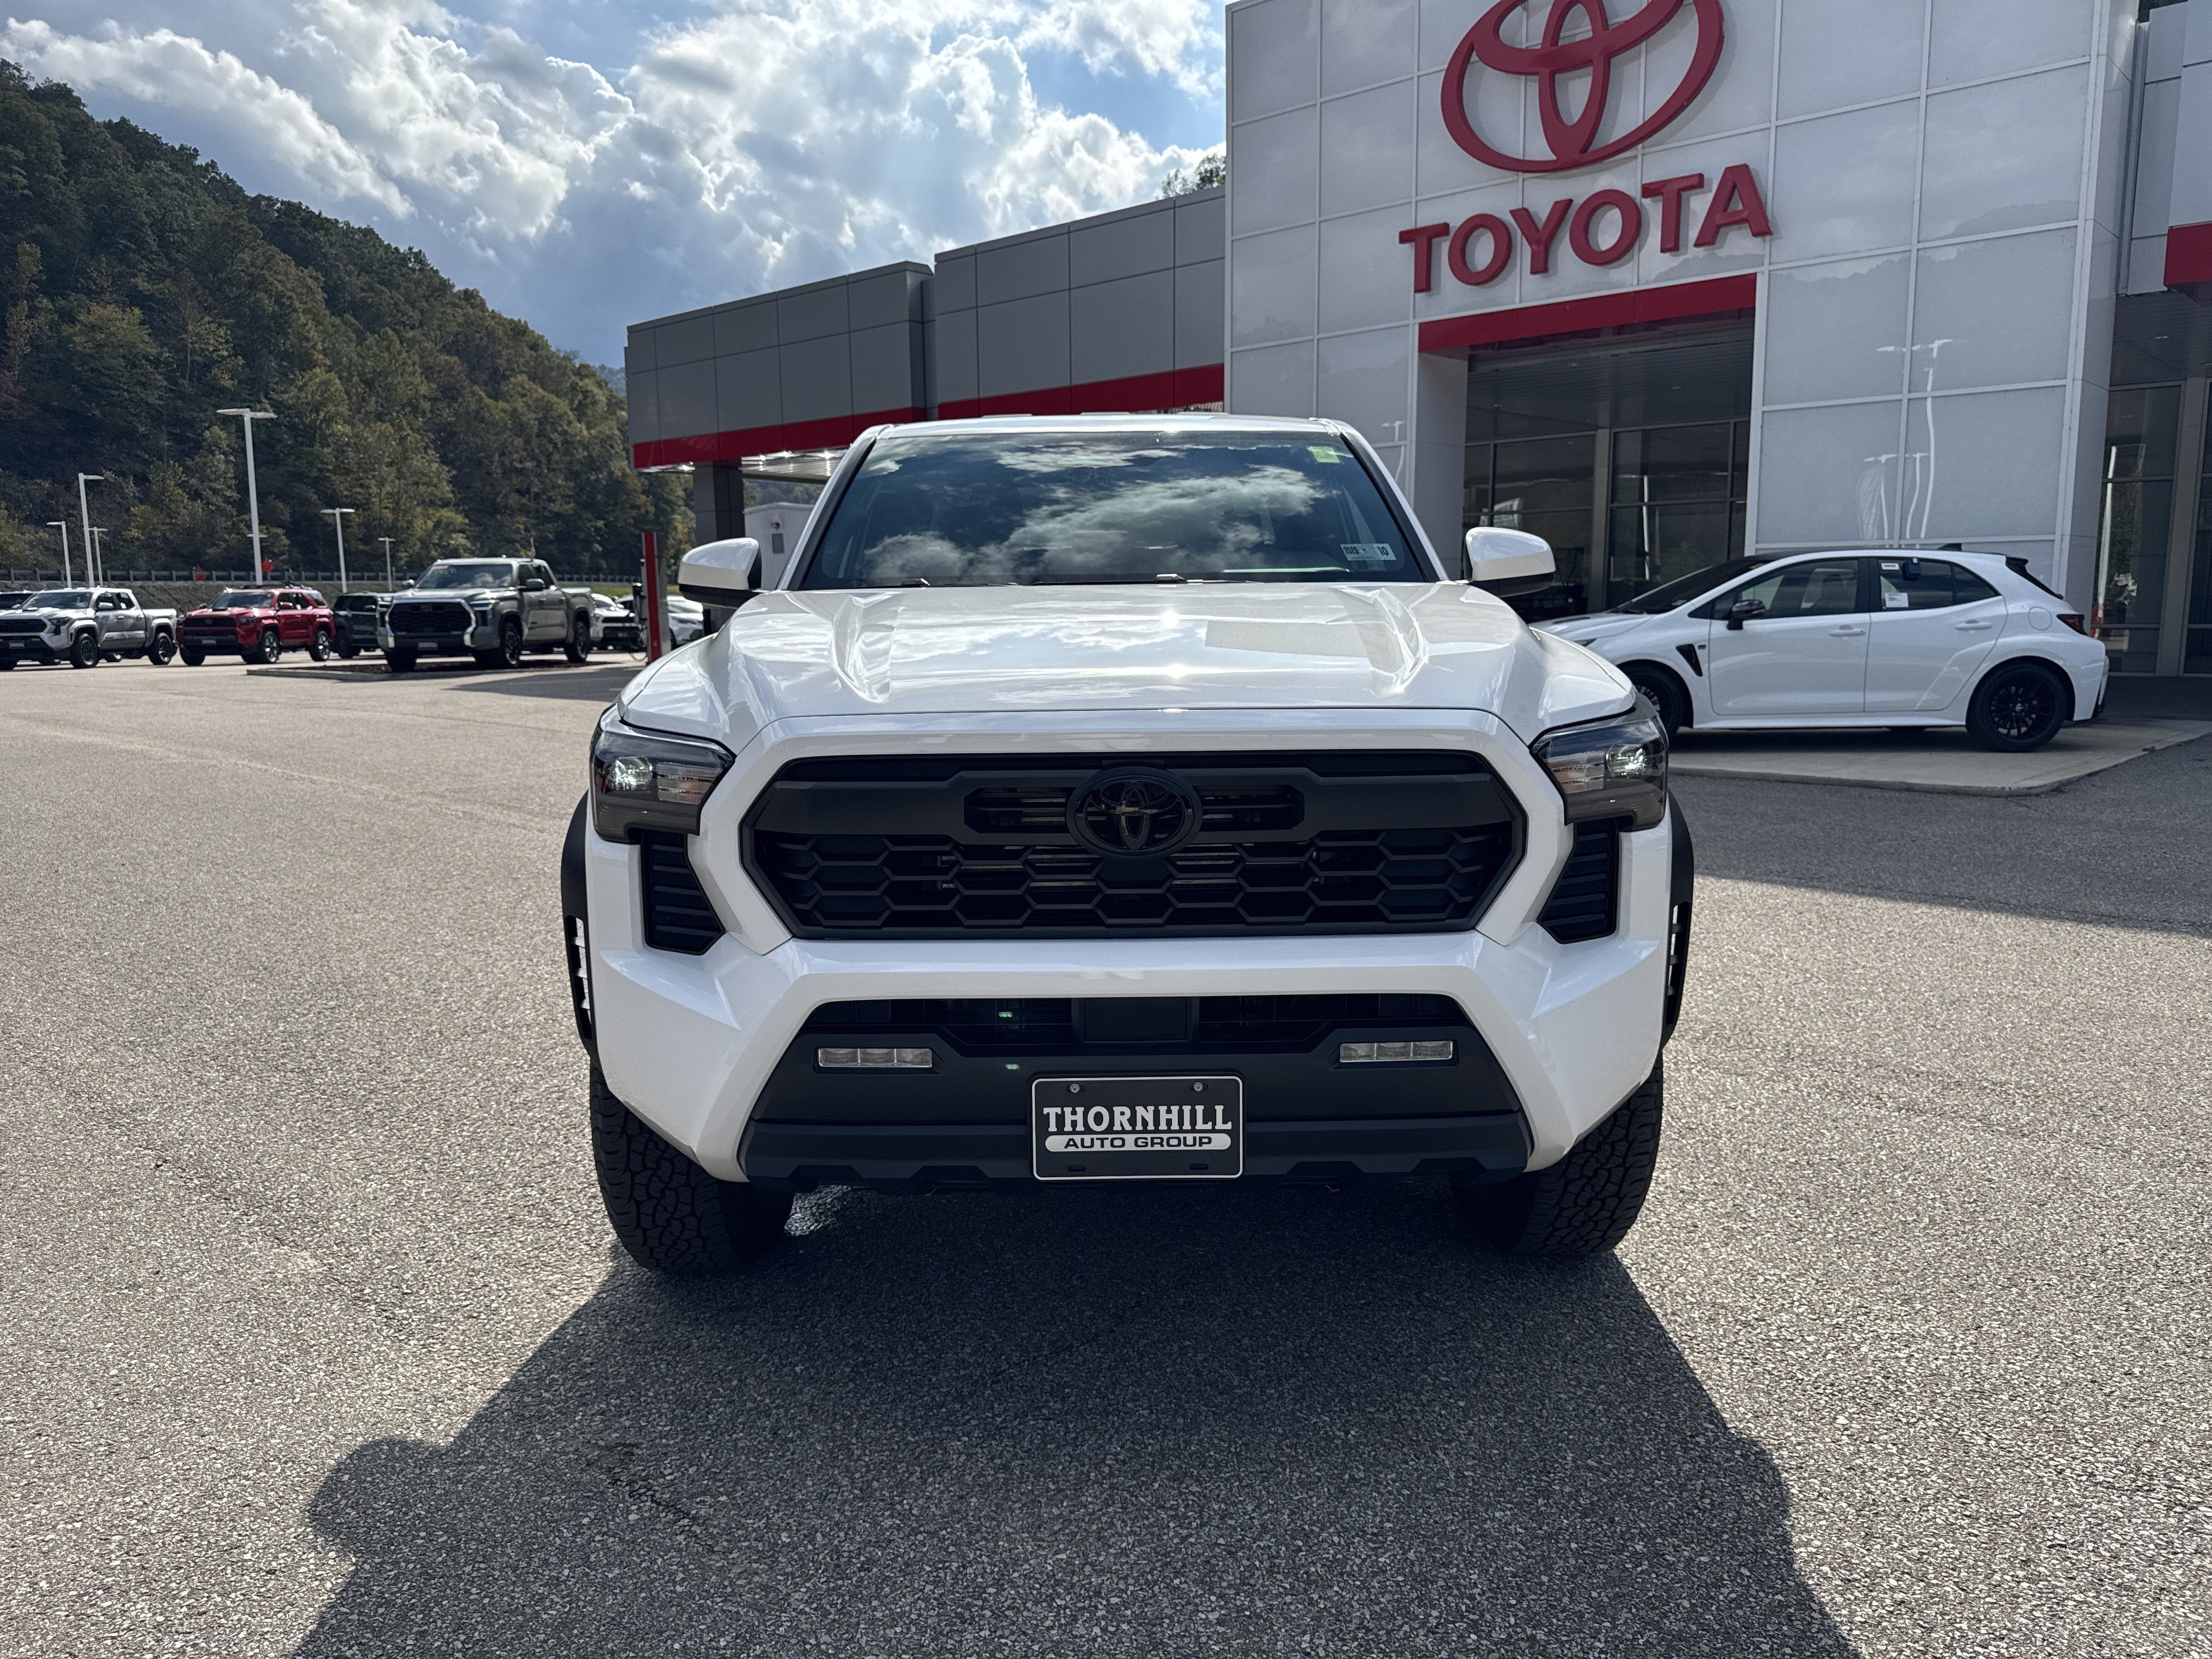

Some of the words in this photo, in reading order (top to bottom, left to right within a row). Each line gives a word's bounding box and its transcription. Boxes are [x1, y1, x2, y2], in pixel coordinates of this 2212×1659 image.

[1399, 163, 1773, 293] TOYOTA
[1377, 546, 1389, 556] 10
[1043, 1105, 1232, 1132] THORNHILL
[1064, 1137, 1126, 1149] AUTO
[1134, 1136, 1212, 1148] GROUP
